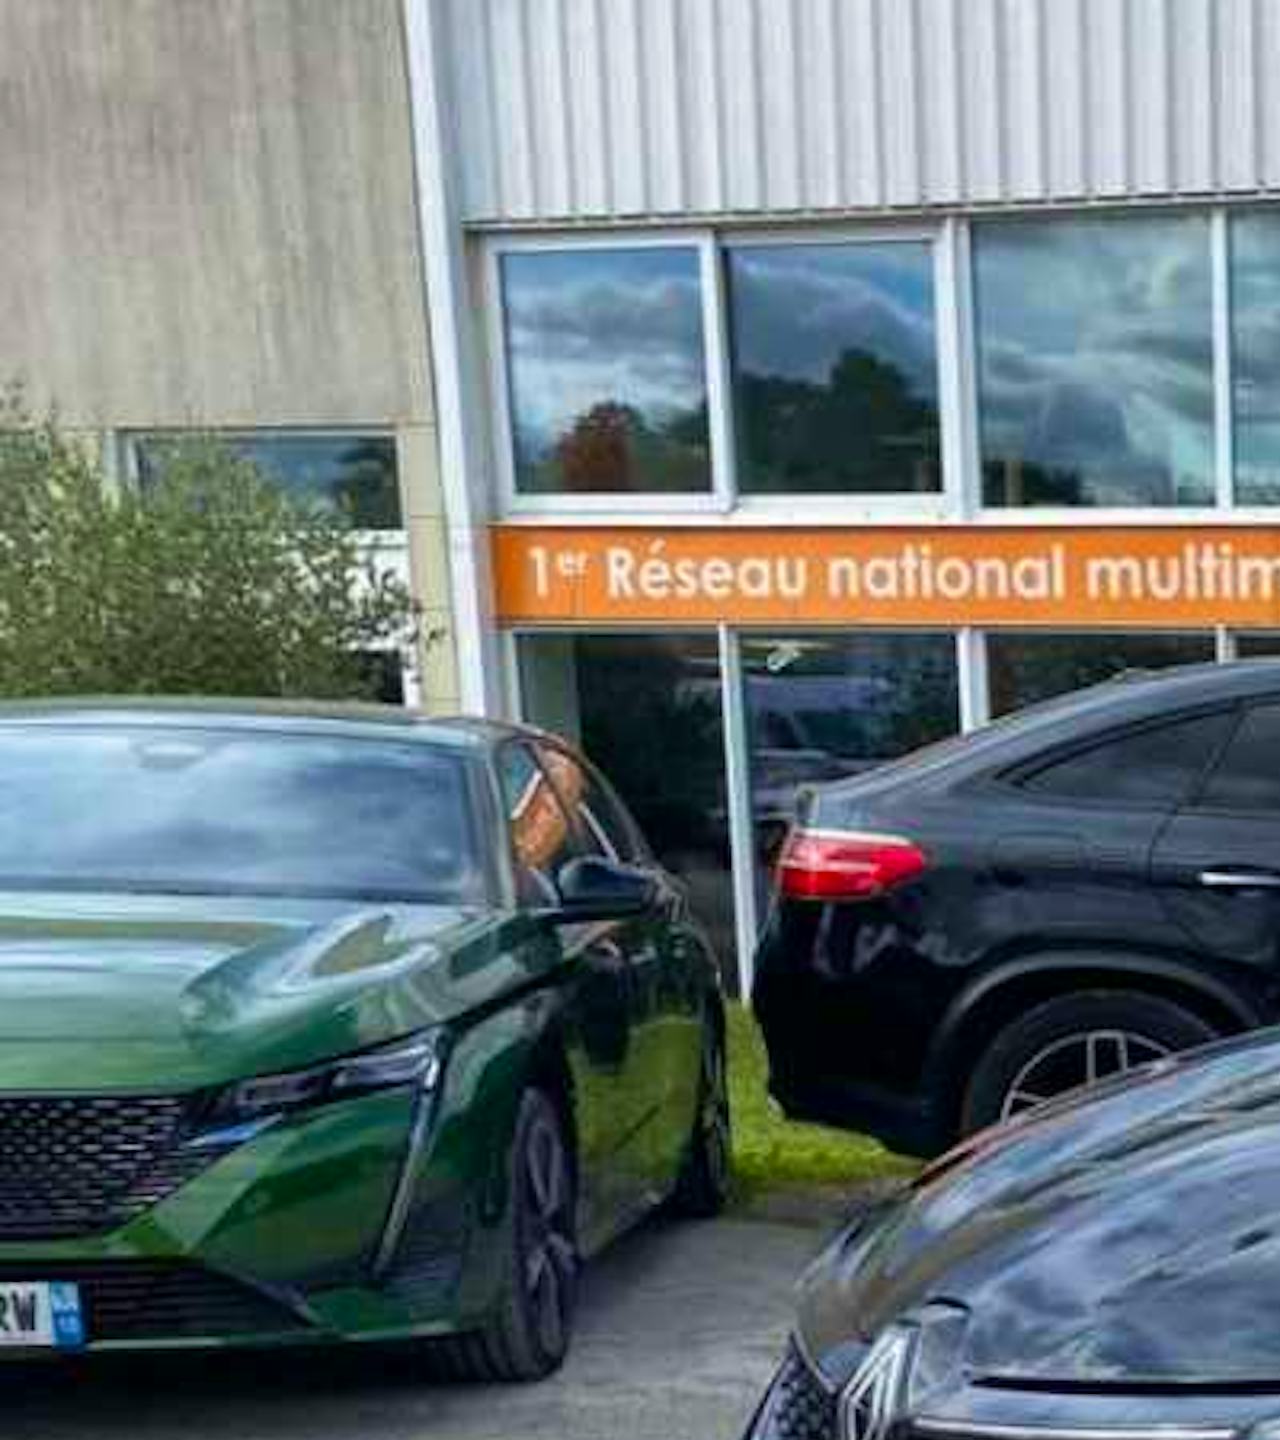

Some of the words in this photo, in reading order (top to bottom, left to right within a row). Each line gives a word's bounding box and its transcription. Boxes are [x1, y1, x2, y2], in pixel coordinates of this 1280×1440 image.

[528, 545, 589, 597] 1er
[607, 538, 808, 601] Réseau
[828, 545, 1066, 601] national
